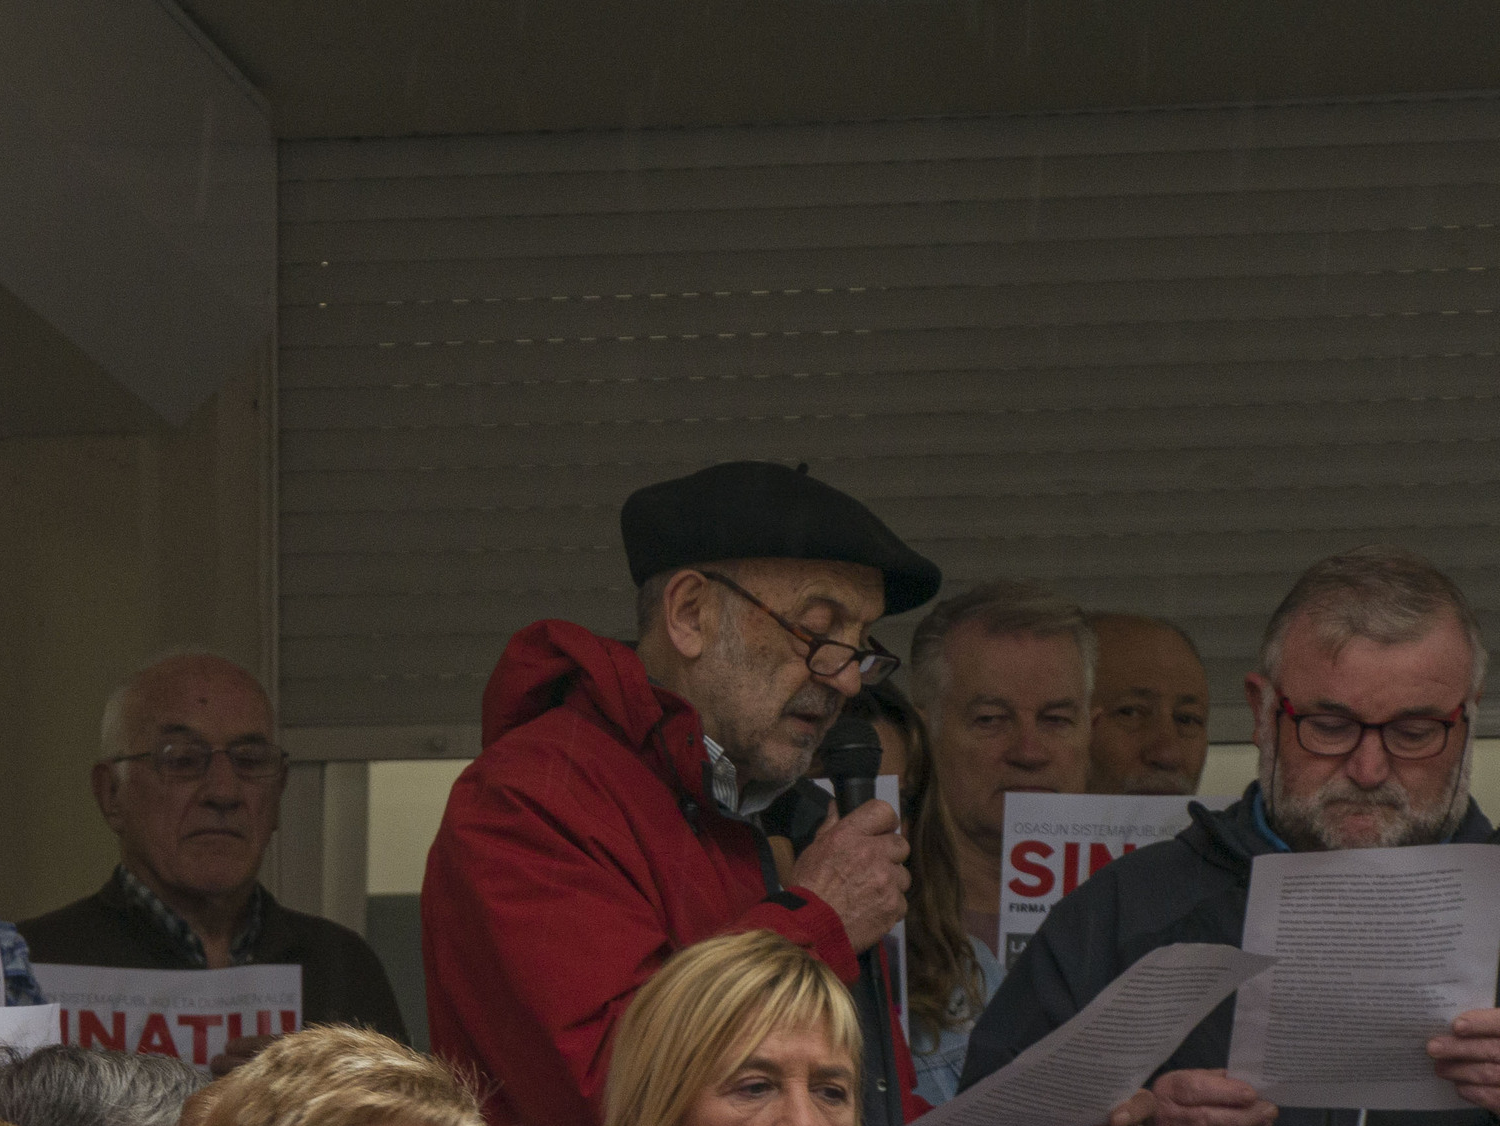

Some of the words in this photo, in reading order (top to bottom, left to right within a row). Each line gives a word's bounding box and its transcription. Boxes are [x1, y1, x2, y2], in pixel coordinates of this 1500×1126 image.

[1014, 822, 1068, 835] OSASUN
[1071, 823, 1126, 836] SISTEMA
[1009, 902, 1047, 914] FIRMA
